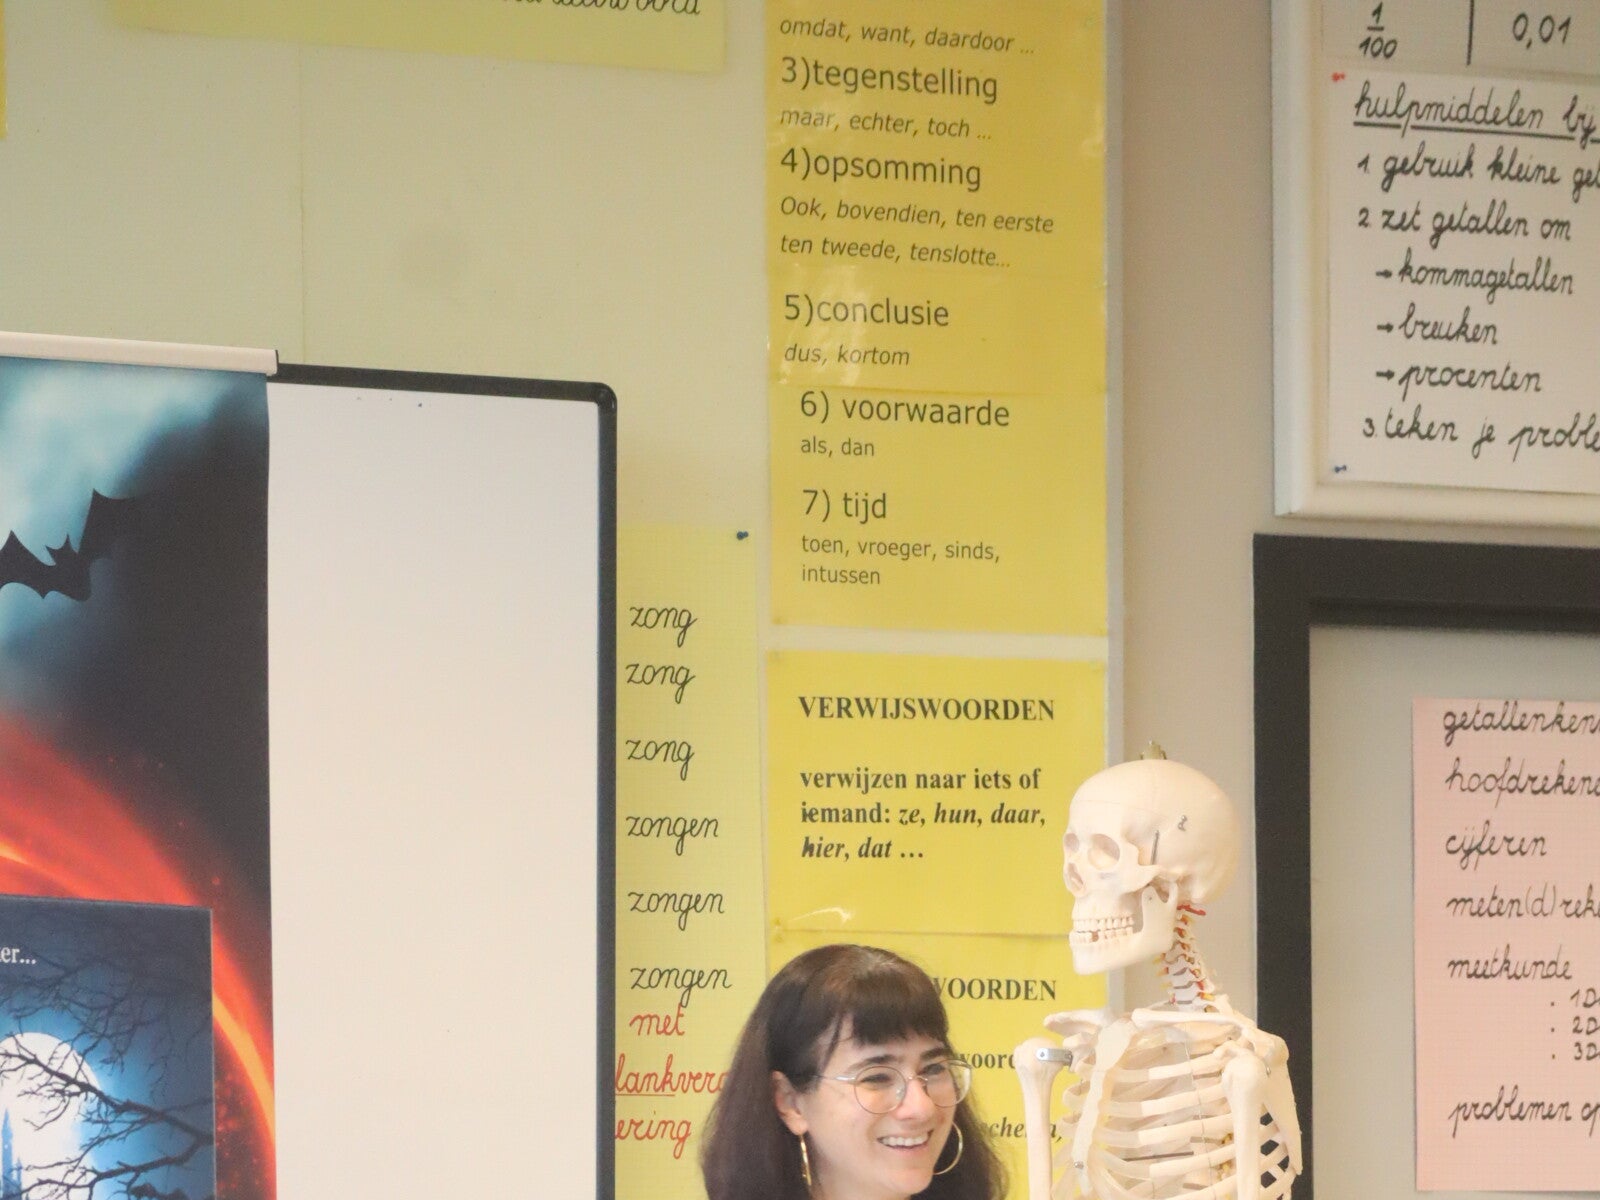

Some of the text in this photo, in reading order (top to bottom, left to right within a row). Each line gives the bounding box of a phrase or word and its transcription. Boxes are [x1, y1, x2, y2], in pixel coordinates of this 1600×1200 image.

[780, 18, 851, 42] omdat,
[861, 24, 915, 48] want,
[925, 27, 1015, 53] daardoor
[1359, 37, 1398, 59] 100
[1513, 13, 1571, 49] 0,01
[780, 108, 840, 131] maar,
[849, 112, 918, 137] echter,
[927, 116, 970, 138] toch
[1354, 80, 1544, 138] hulpmiddelen
[780, 147, 981, 192] 4)opsomming
[1381, 140, 1474, 193] gebruik
[1487, 144, 1561, 184] kleine
[781, 196, 1054, 234] Ook, bovendien, ten eerste
[1381, 200, 1421, 231] zet
[1429, 198, 1529, 249] getallen
[1540, 218, 1571, 241] om
[781, 235, 812, 254] ten
[821, 236, 901, 263] tweede,
[1399, 247, 1574, 304] kommagetallen
[784, 294, 949, 327] 5)conclusie
[1398, 302, 1498, 345] breuken
[784, 344, 910, 366] dus, kortom
[1398, 362, 1542, 402] procenten
[800, 390, 1010, 426] 6) voorwaarde
[800, 437, 875, 458] als, dan
[1384, 404, 1459, 442] teken
[1472, 416, 1496, 459] je
[802, 489, 887, 525] 7) tijd
[801, 535, 1000, 563] toen, vroeger, sinds,
[801, 564, 881, 585] intussen
[629, 606, 698, 648] zong
[625, 663, 696, 704] zong
[798, 696, 1055, 721] VERWIJSWOORDEN
[625, 739, 695, 781] zong
[800, 766, 1042, 795] verwijzen naar iets of
[801, 801, 1046, 827] iemand: ze, hun, daar,
[625, 815, 719, 856] zongen
[801, 836, 850, 862] hier,
[857, 838, 893, 859] dat
[1446, 819, 1548, 871] cijferen
[627, 891, 725, 931] zongen
[1448, 943, 1572, 980] meetkunde
[630, 966, 732, 1008] zongen
[629, 1002, 686, 1036] met
[1448, 1085, 1572, 1139] problemen
